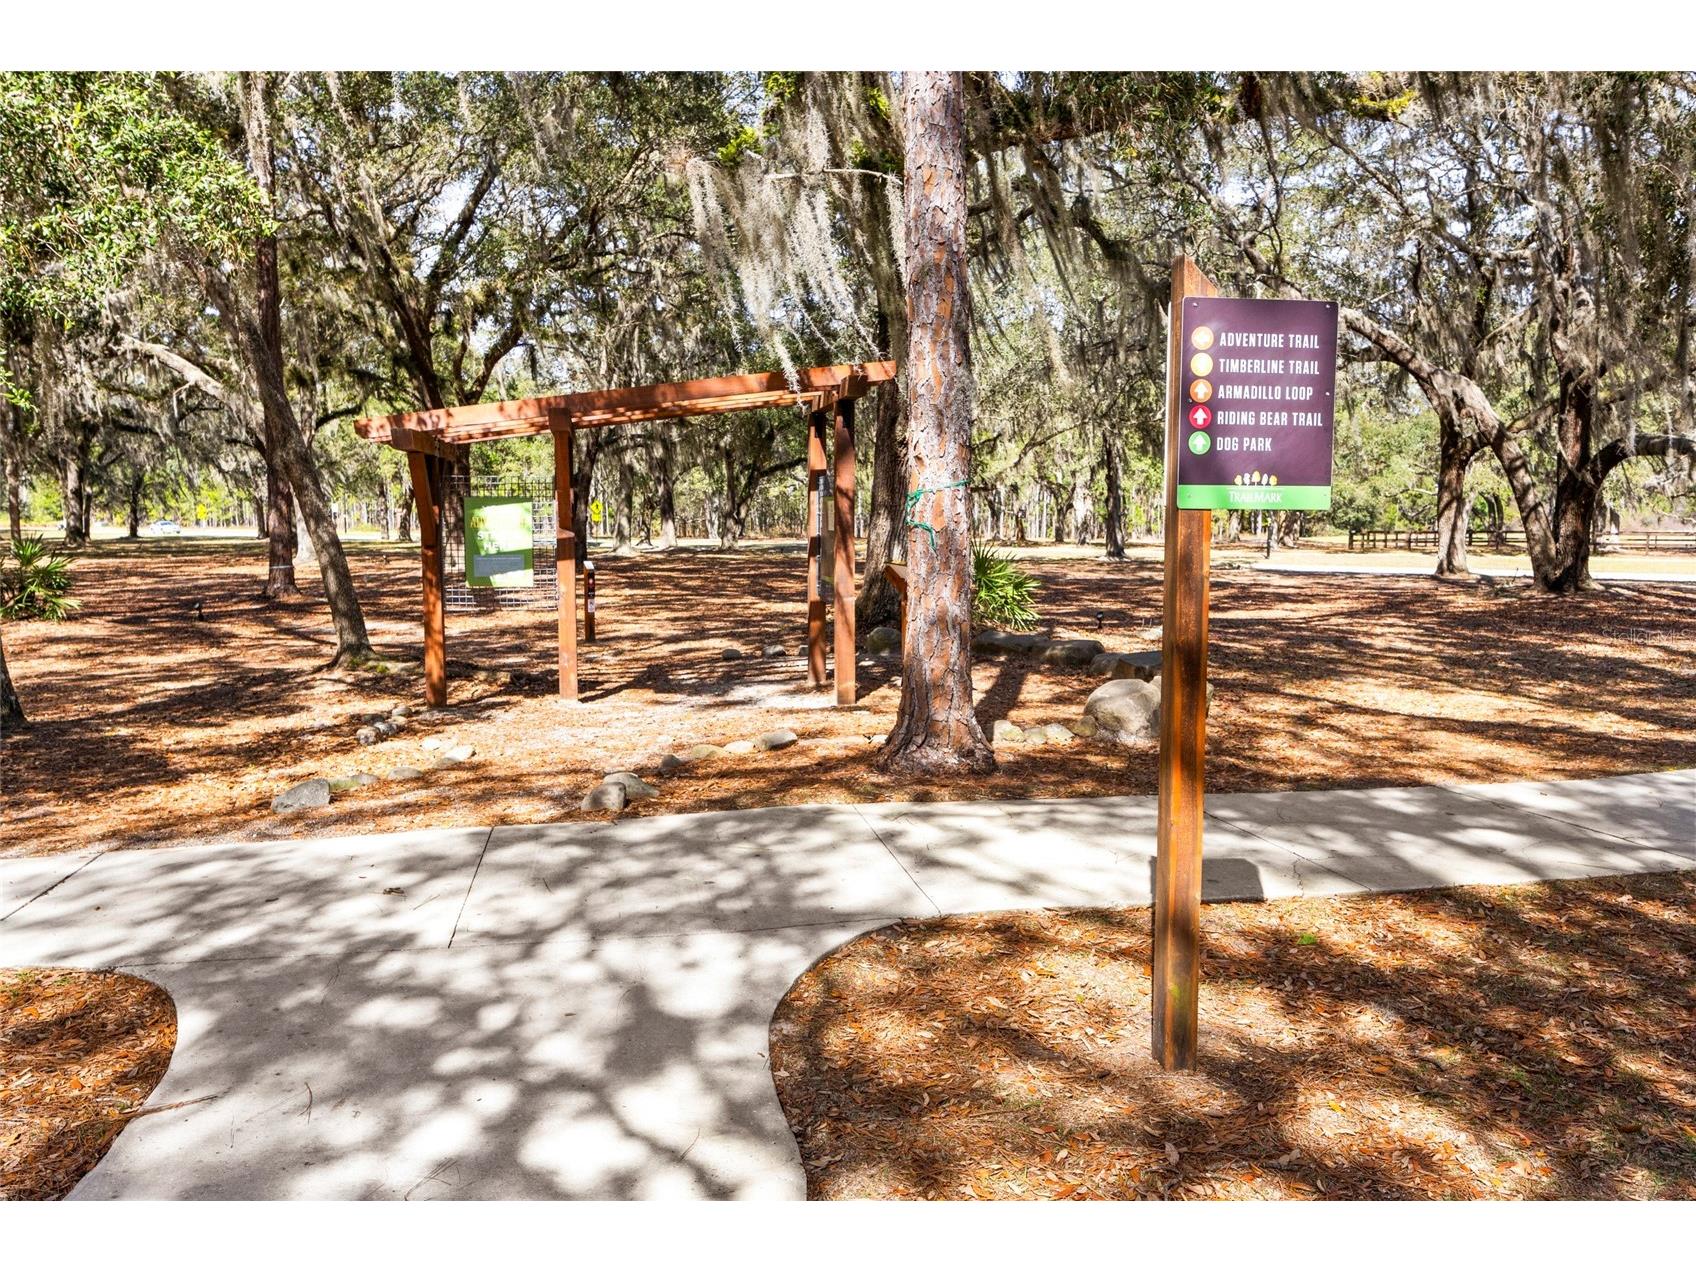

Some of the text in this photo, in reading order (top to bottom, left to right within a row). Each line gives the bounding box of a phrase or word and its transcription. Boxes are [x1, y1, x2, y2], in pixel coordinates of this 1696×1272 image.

[1219, 333, 1320, 348] ADVENTURE TRAIL
[1218, 359, 1320, 374] TIMBERLINE TRAIL
[1217, 385, 1313, 400] ARMADILLO LOOP
[1216, 411, 1323, 426] RIDING BEAR TRAIL
[1216, 437, 1272, 451] DOG PARK
